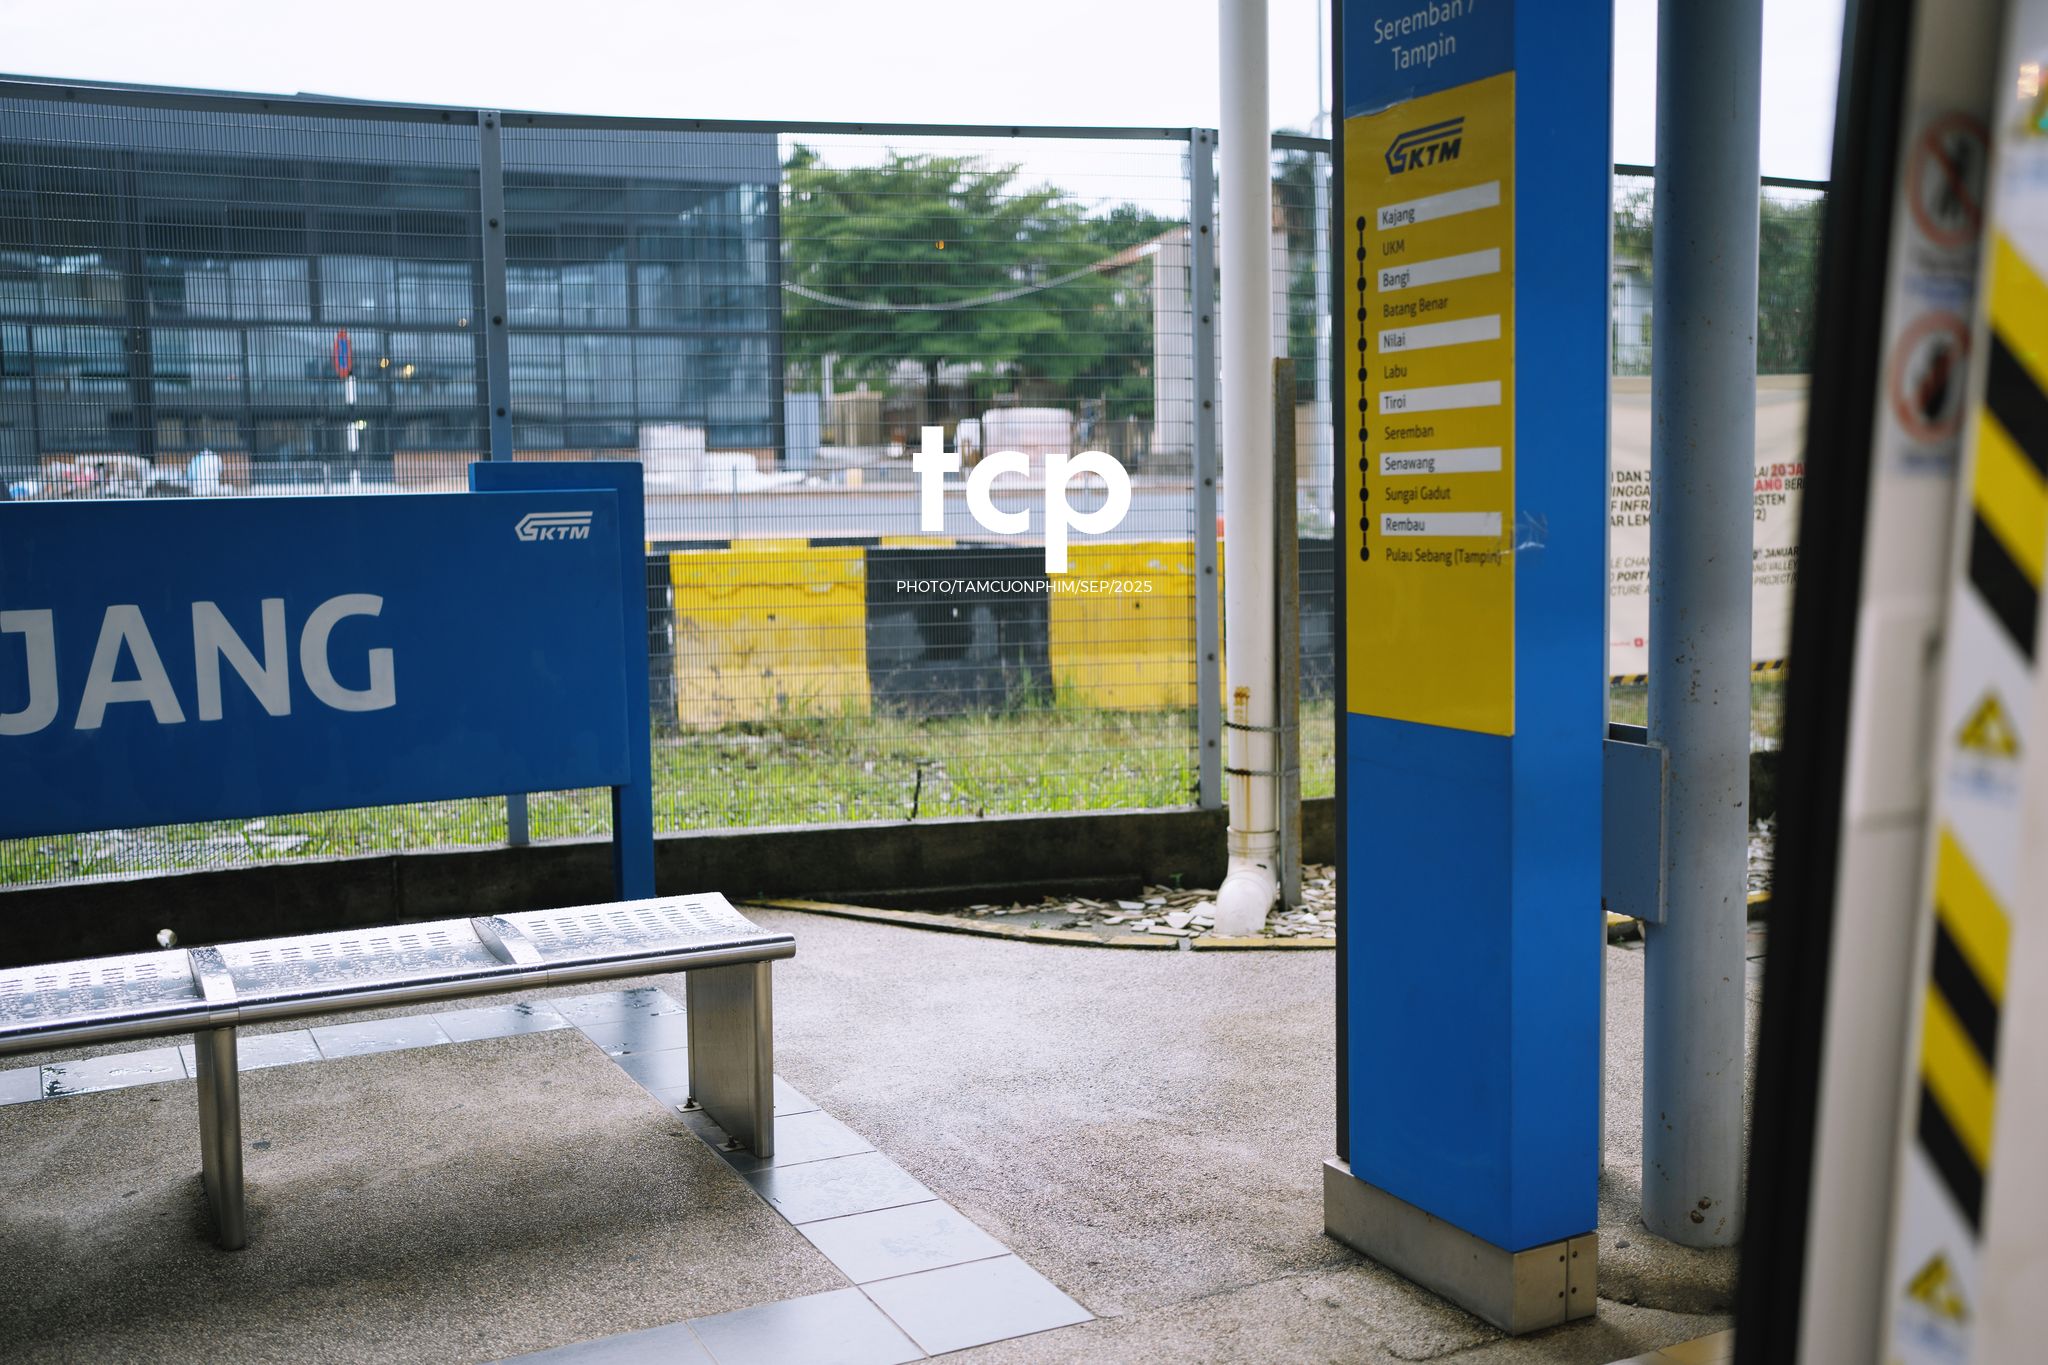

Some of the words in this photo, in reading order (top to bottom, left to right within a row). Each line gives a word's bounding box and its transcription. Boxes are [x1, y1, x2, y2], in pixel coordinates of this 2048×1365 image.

[1374, 0, 1462, 44] Seremban
[1392, 32, 1456, 71] Tampin
[1382, 208, 1415, 225] Kajang
[1382, 239, 1405, 256] UKM
[1383, 269, 1410, 288] Bangi
[1383, 300, 1417, 318] Batang
[1419, 297, 1449, 313] Benar
[1383, 332, 1406, 348] Nilai
[1384, 364, 1408, 380] Labu
[1384, 395, 1406, 410] Tiroi
[1384, 425, 1434, 440] Seremban
[1384, 456, 1435, 473] Senawang
[1771, 463, 1786, 477] 20
[1616, 471, 1642, 483] DAN
[1385, 486, 1418, 504] Sungai
[1420, 485, 1451, 500] Gadut
[1620, 500, 1651, 512] INFR
[1385, 517, 1425, 532] Rembau
[1385, 547, 1413, 562] Pulau
[1415, 548, 1453, 567] Sebang
[1617, 571, 1645, 581] PORT
[0, 594, 396, 736] JANG
